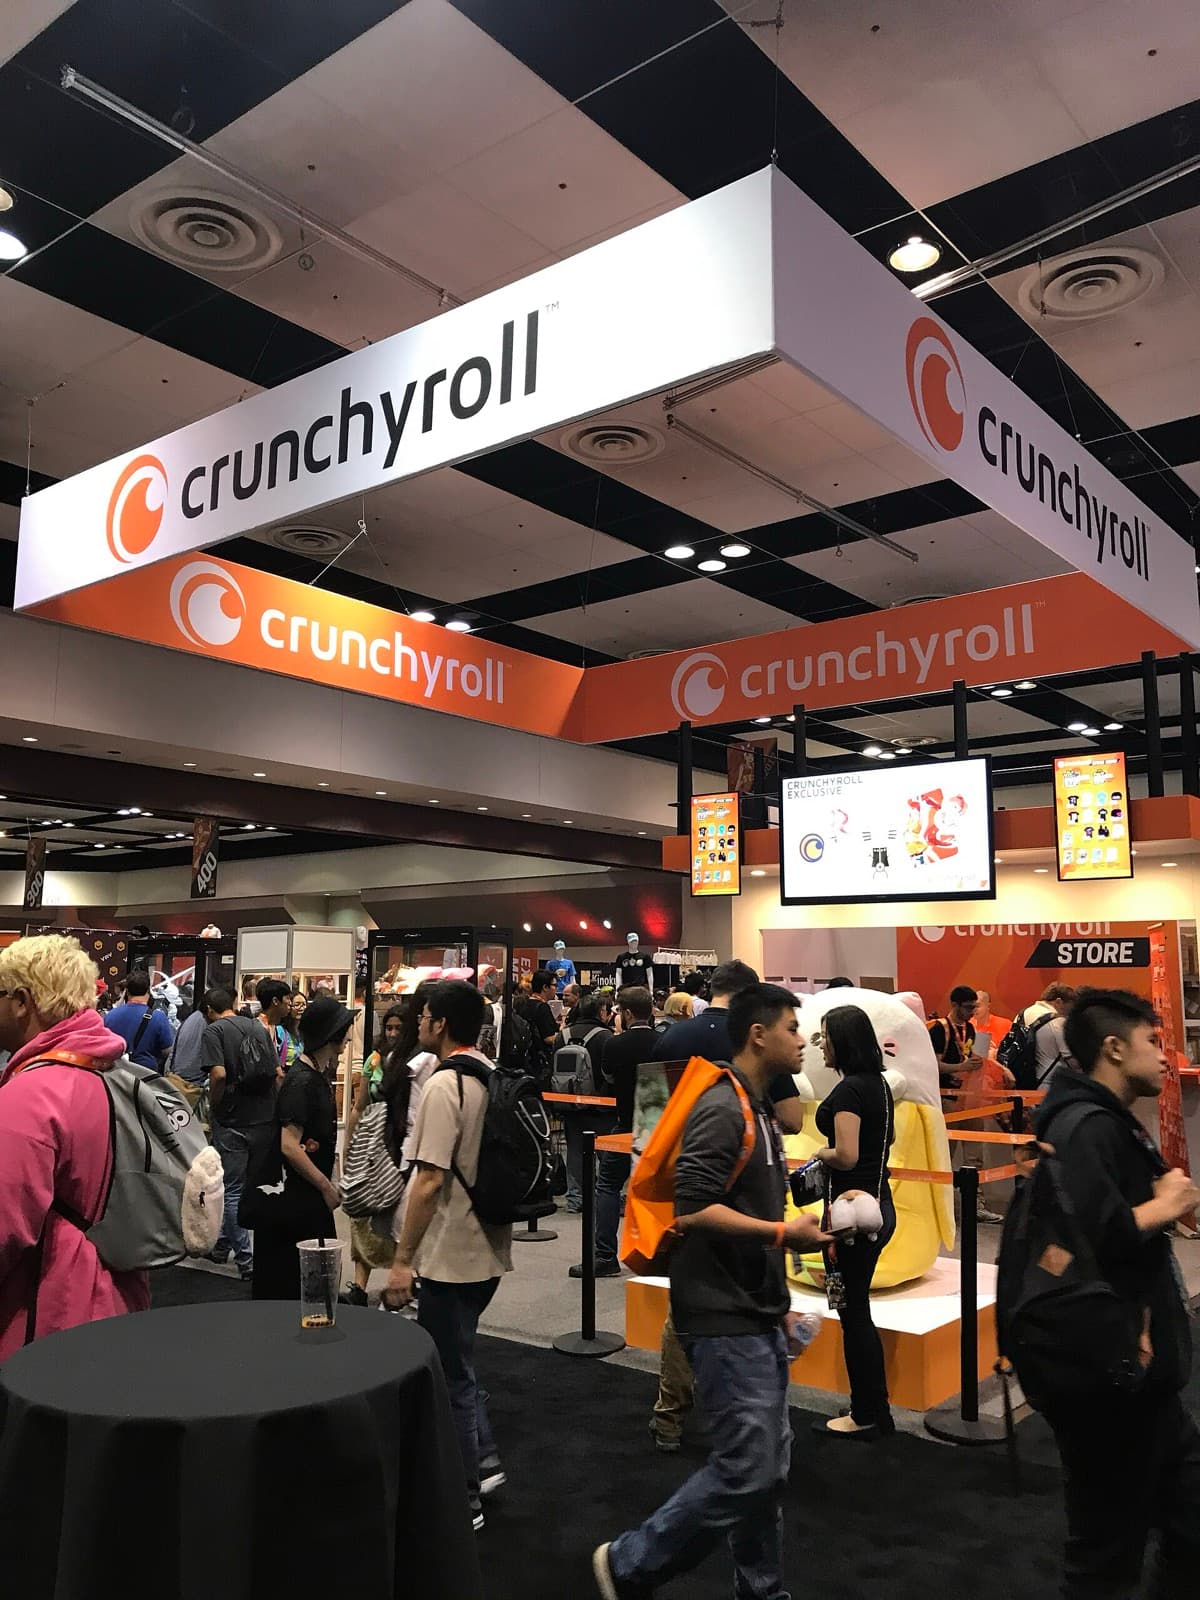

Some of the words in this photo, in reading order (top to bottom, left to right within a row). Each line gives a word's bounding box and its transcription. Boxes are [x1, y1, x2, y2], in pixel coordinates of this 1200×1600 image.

[180, 309, 539, 519] crunchyroll
[978, 406, 1150, 581] crunchyroll
[260, 608, 504, 704] crunchyroll
[740, 603, 1034, 699] crunchyroll
[787, 775, 863, 790] CRUNCHYROLL
[787, 786, 843, 800] EXCLUSIVE
[26, 870, 44, 907] 300
[197, 851, 217, 894] 400
[1057, 941, 1134, 965] STORE
